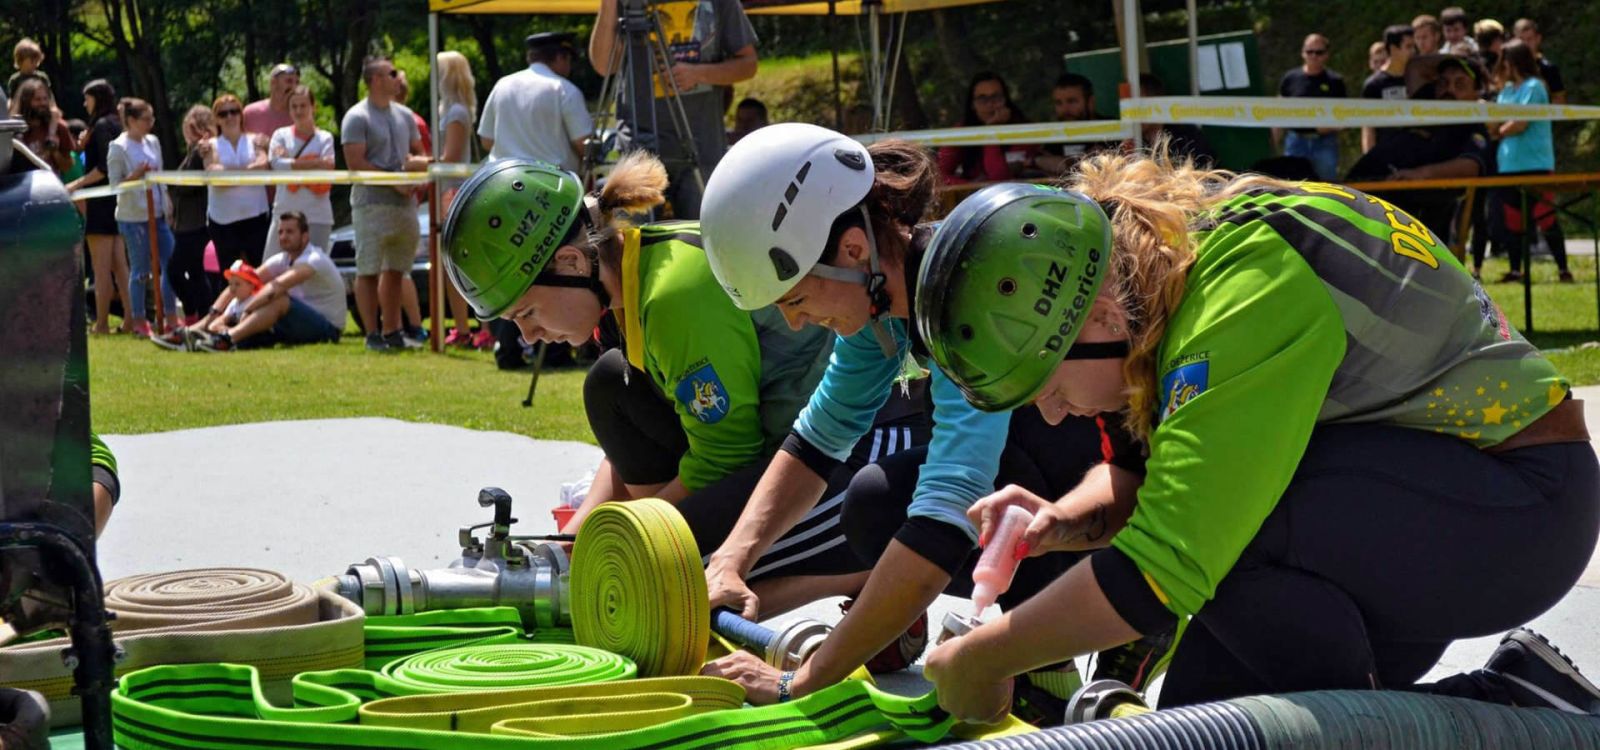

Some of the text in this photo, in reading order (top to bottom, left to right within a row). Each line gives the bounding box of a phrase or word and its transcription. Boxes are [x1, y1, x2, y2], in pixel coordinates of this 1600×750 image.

[510, 208, 541, 247] DHZ
[520, 205, 572, 275] Dežerice
[1033, 260, 1069, 317] DHZ
[1045, 247, 1101, 354] Dežerice
